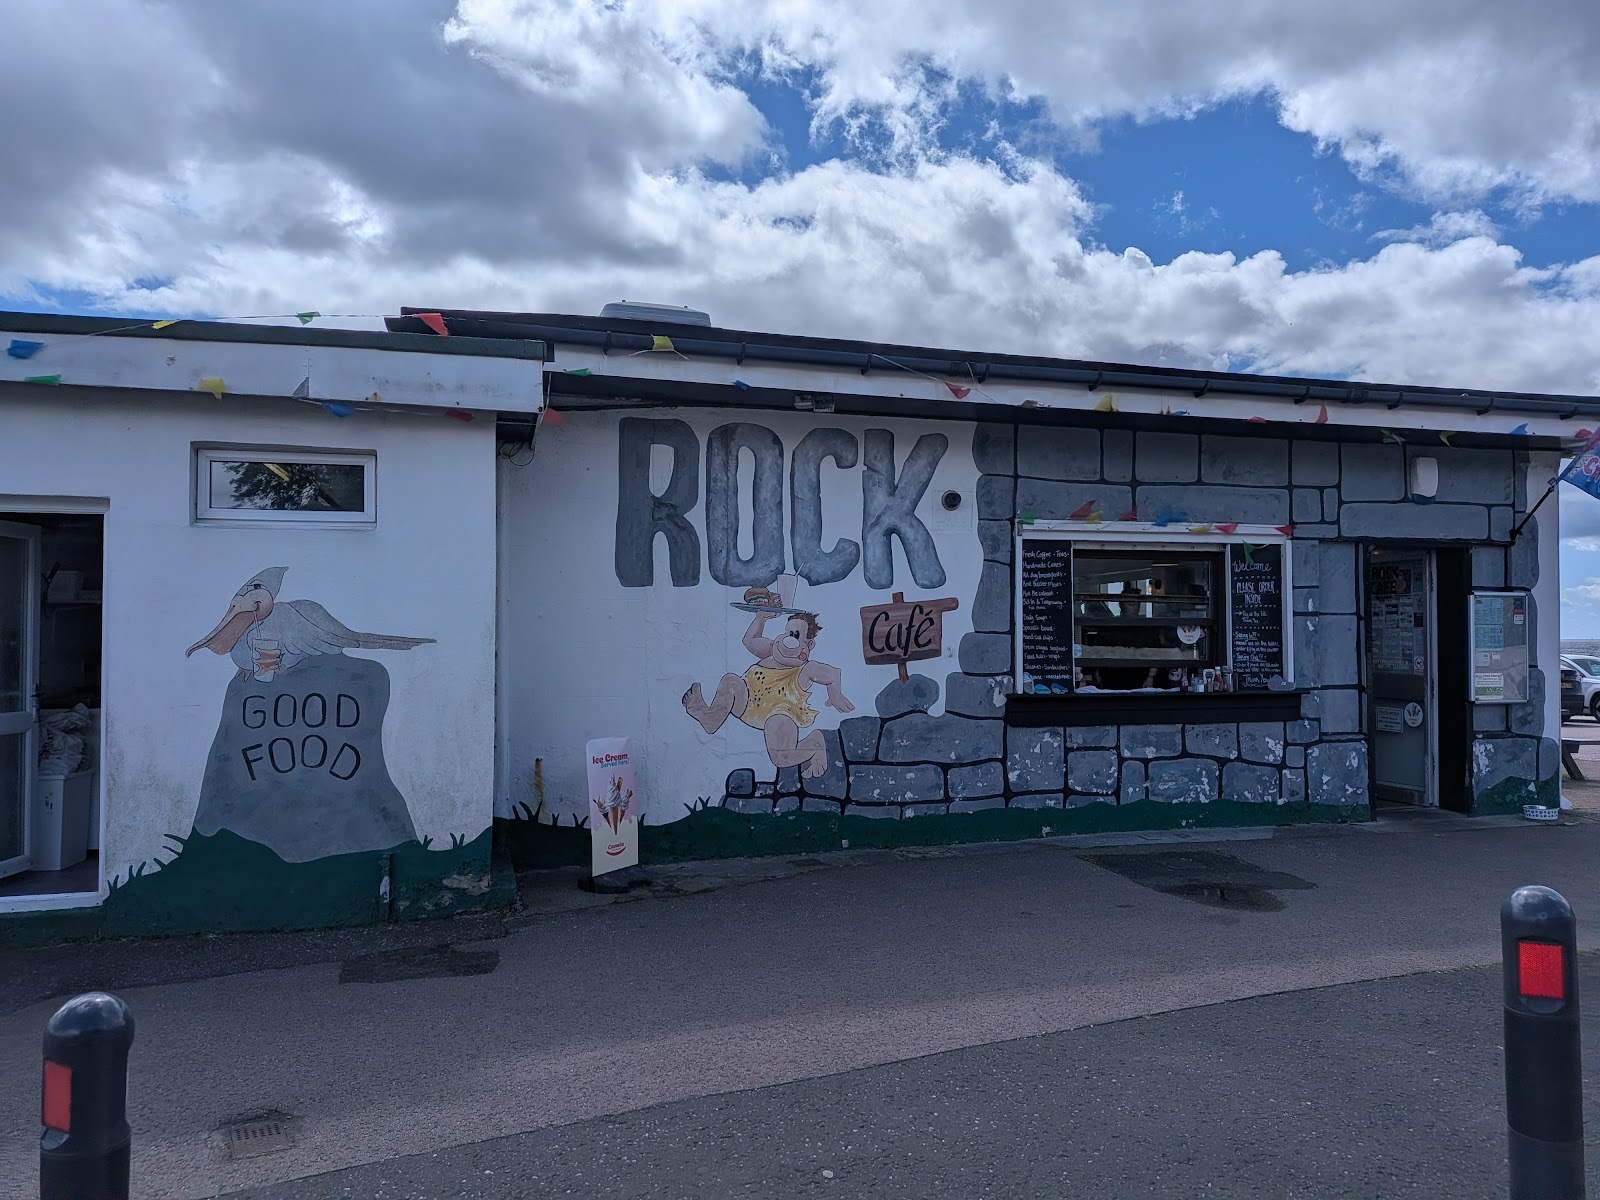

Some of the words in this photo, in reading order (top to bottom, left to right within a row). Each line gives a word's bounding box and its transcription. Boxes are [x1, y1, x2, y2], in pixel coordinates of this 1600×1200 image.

[614, 416, 948, 589] ROCK
[1036, 550, 1051, 560] Coffee
[1232, 559, 1272, 572] Welcome
[1236, 581, 1255, 593] PLEASE
[1258, 580, 1275, 593] ORDER
[1244, 593, 1263, 604] INSIDE
[868, 603, 935, 657] Café
[1242, 674, 1260, 685] Thank
[242, 692, 360, 729] GOOD
[241, 734, 361, 781] FOOD
[592, 756, 604, 765] Ice
[605, 753, 628, 762] Cream
